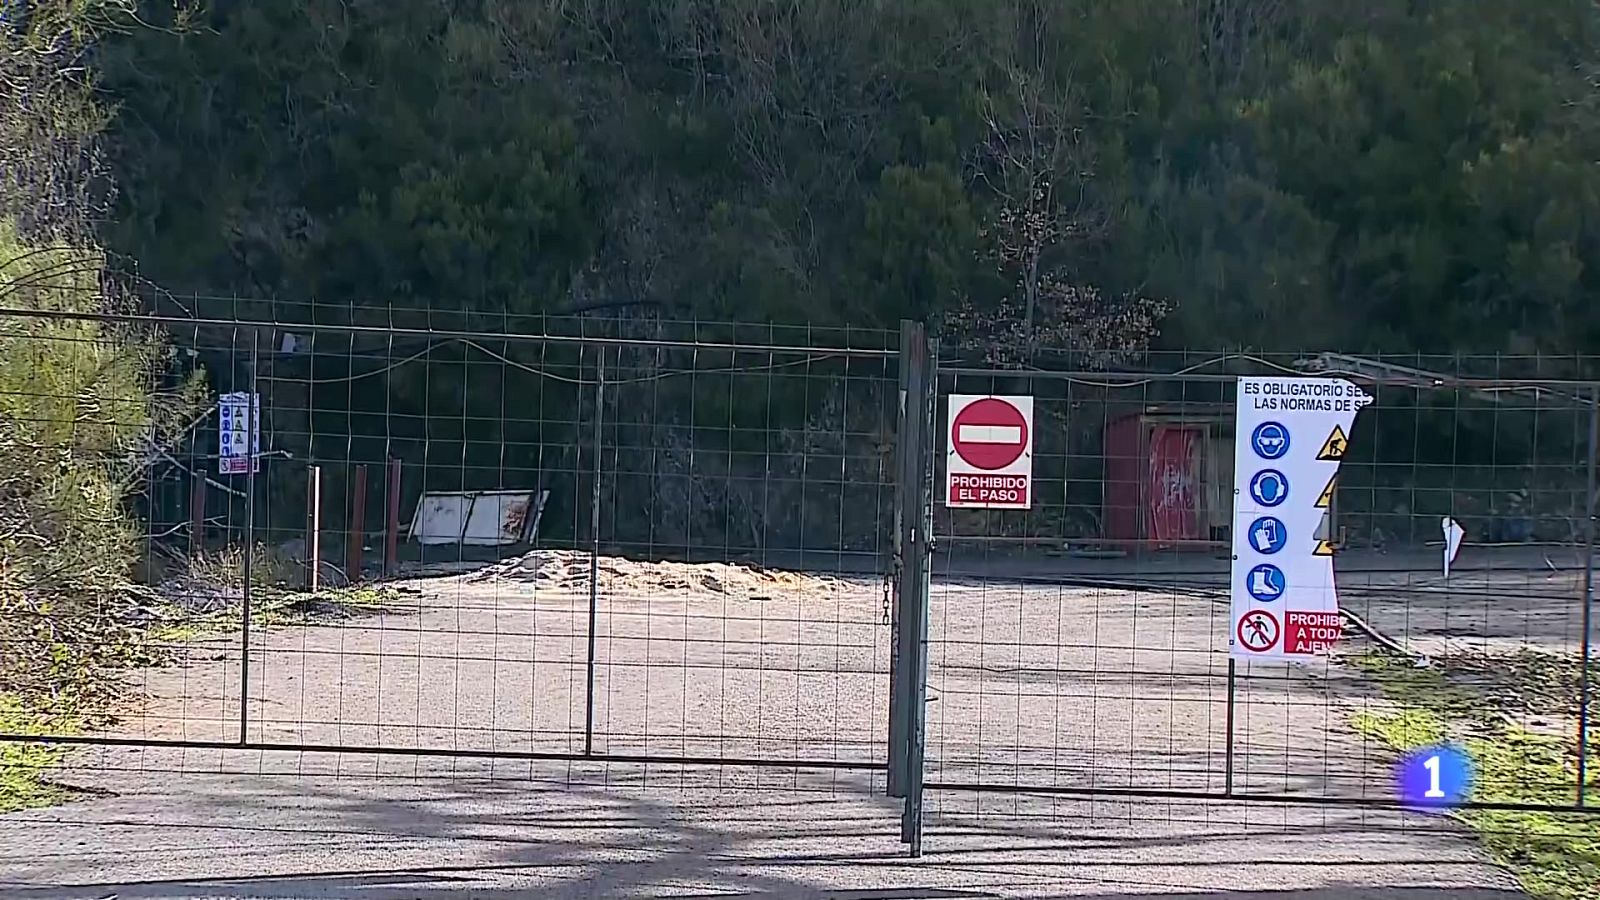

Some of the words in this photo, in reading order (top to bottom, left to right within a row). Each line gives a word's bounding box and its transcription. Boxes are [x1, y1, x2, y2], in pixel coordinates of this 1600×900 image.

[1244, 382, 1260, 394] ES
[1263, 383, 1343, 397] OBLIGATORIO
[1254, 398, 1277, 409] LAS
[1280, 399, 1331, 411] NORMAS
[1334, 400, 1351, 411] DE
[951, 476, 1026, 489] PROHIBIDO
[959, 489, 976, 500] EL
[980, 490, 1018, 501] PASO
[1296, 628, 1307, 639] A
